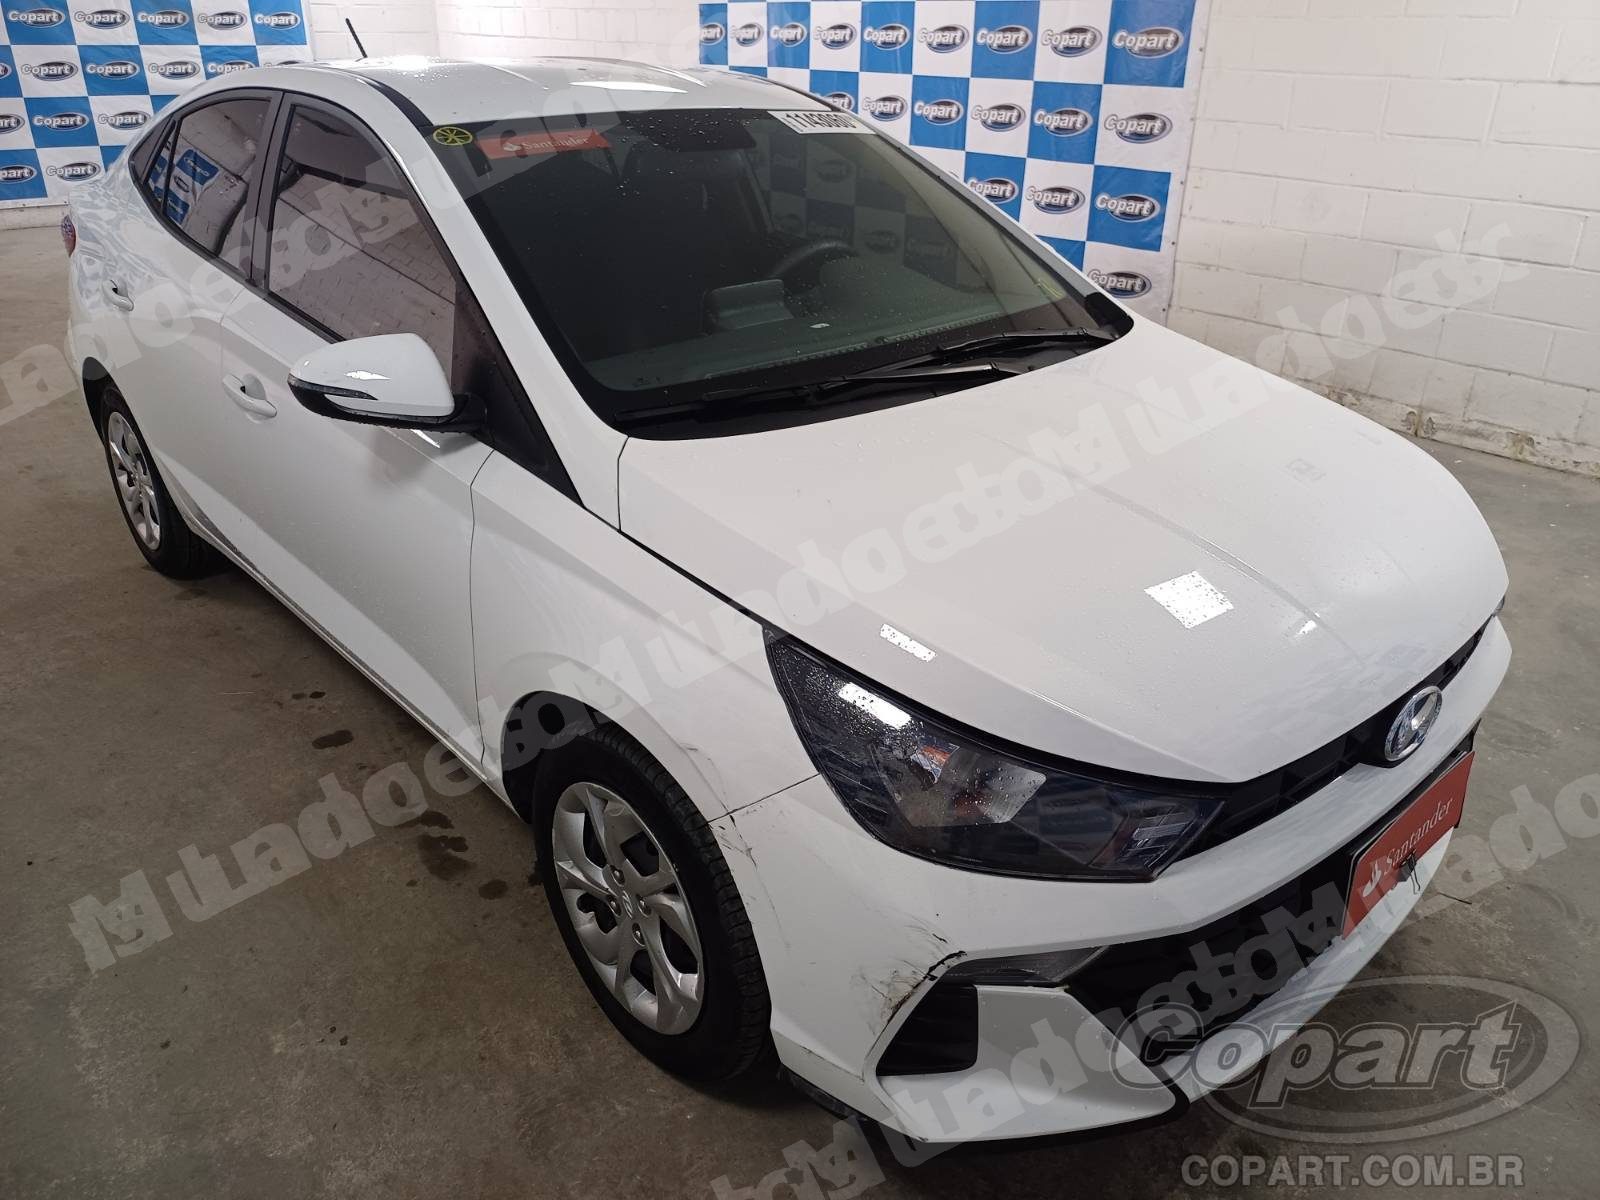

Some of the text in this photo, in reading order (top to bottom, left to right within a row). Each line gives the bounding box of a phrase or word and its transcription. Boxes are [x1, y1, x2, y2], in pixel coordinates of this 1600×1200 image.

[8, 10, 59, 25] Copart
[75, 10, 122, 24] Copart
[138, 12, 183, 25] Copart
[199, 14, 241, 27] Copart
[254, 14, 297, 27] Copart
[863, 28, 907, 45] Copart
[919, 28, 963, 47] Copart
[976, 28, 1025, 48] Copart
[1042, 30, 1092, 50] Copart
[1113, 31, 1176, 53] Copart
[21, 63, 71, 77] Copart
[86, 63, 134, 77] Copart
[149, 63, 193, 77] Copart
[863, 98, 902, 114] Copart
[914, 102, 957, 119] Copart
[33, 115, 84, 129] Copart
[98, 114, 144, 126] Copart
[971, 106, 1018, 124] Copart
[1034, 110, 1084, 130] Copart
[1105, 115, 1162, 137] Copart
[47, 165, 94, 180] Copart
[1026, 187, 1075, 207] Copart
[1096, 194, 1152, 217] Copart
